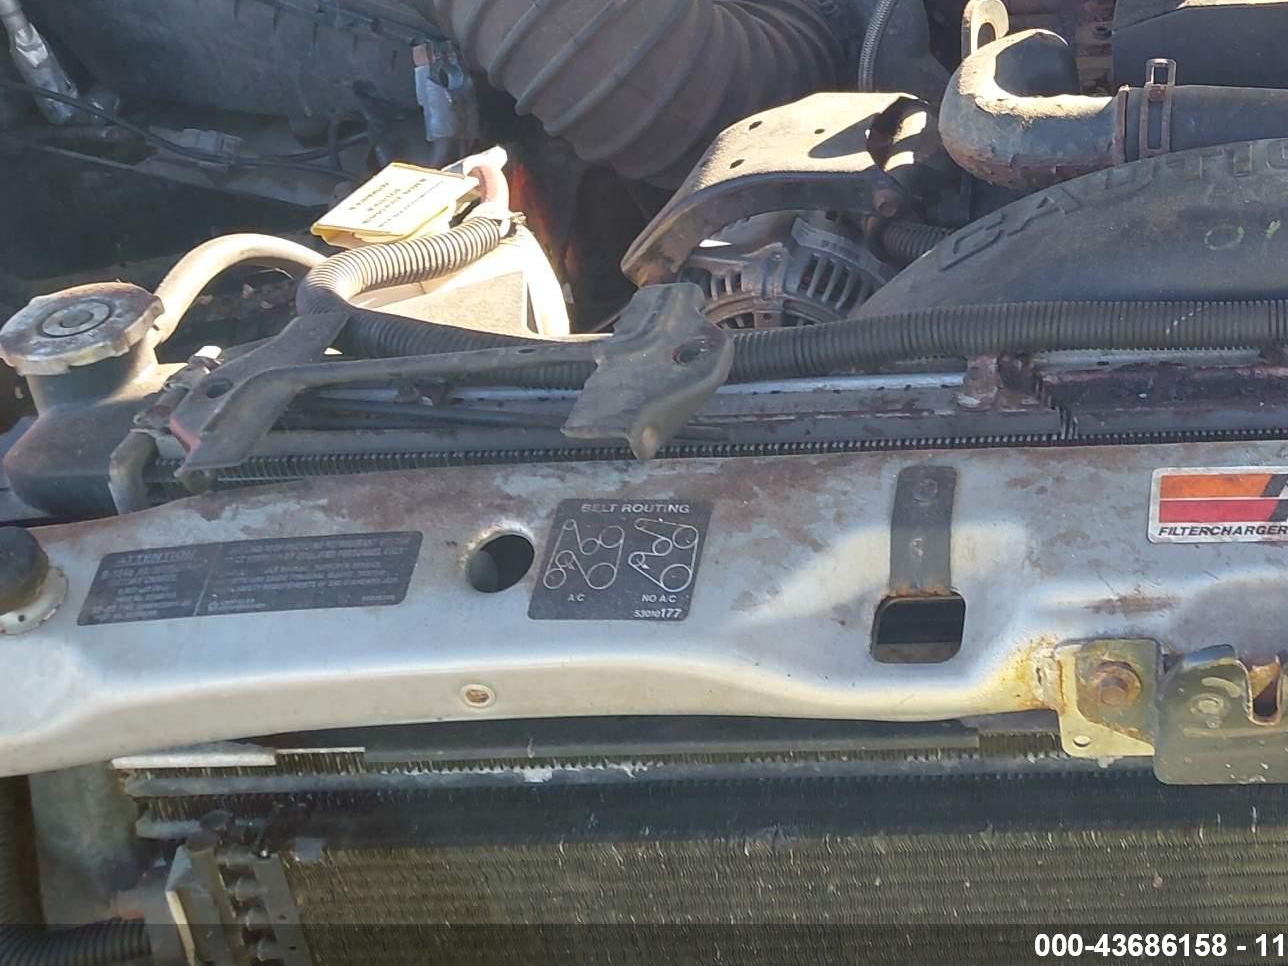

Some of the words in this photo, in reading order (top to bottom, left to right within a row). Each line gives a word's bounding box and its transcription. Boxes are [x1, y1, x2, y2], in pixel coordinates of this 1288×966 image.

[581, 503, 617, 513] BELT
[621, 503, 690, 514] ROUTING
[117, 549, 196, 565] ATTENTION
[641, 593, 657, 603] NO
